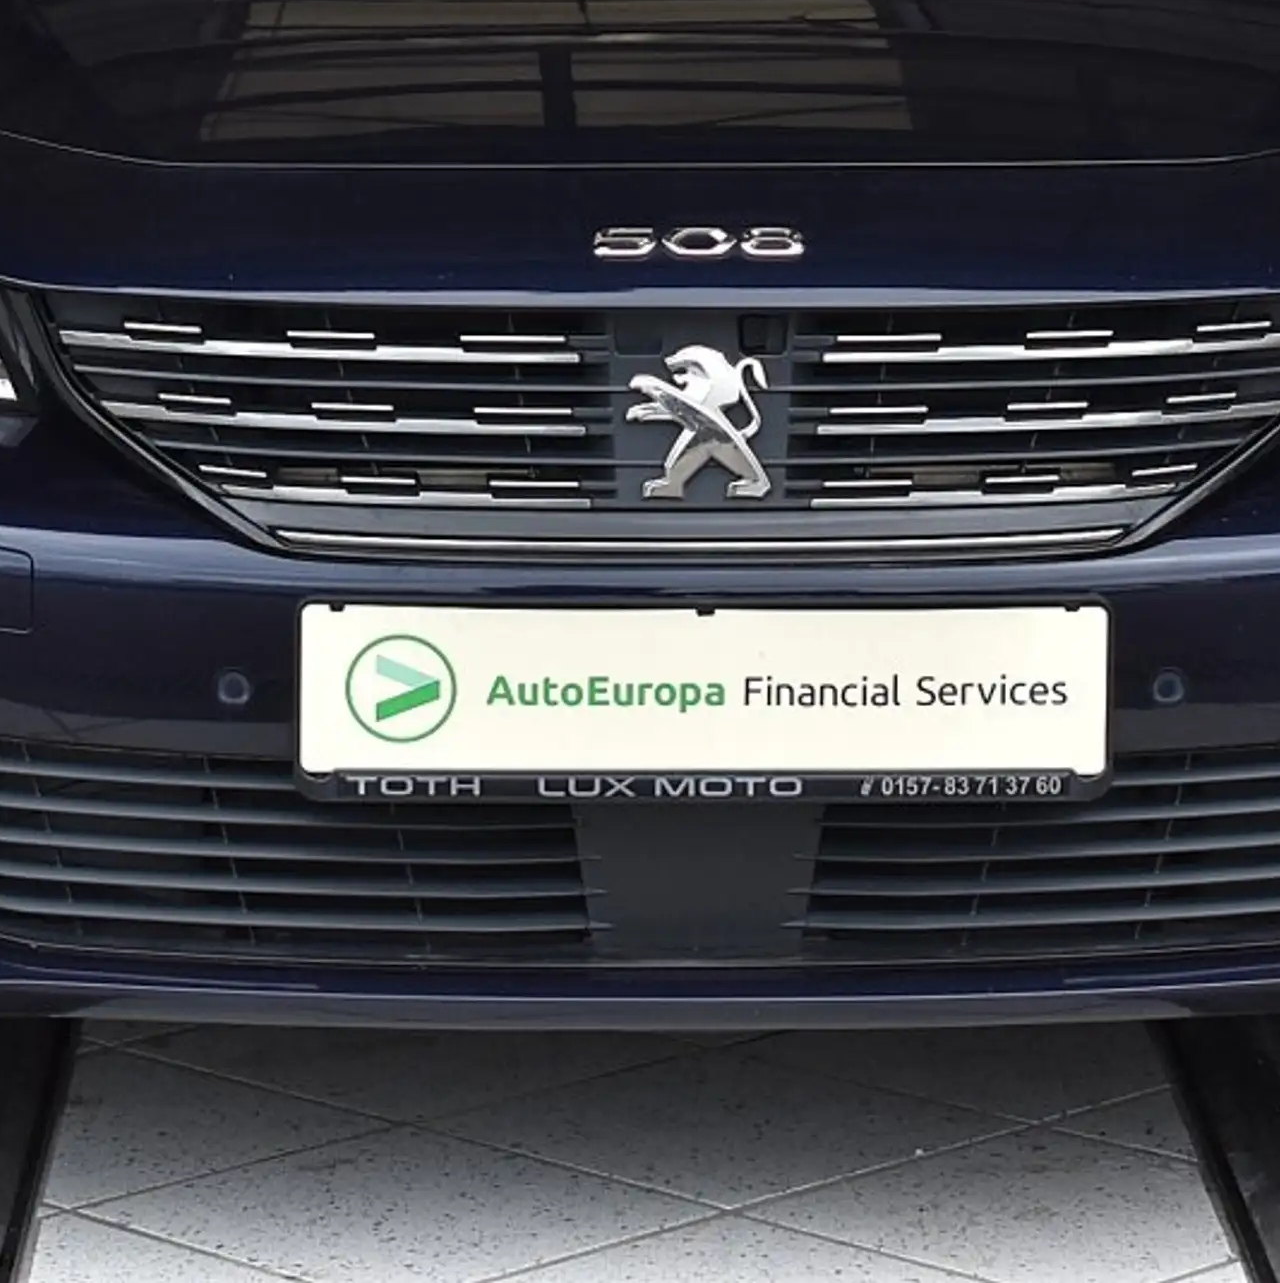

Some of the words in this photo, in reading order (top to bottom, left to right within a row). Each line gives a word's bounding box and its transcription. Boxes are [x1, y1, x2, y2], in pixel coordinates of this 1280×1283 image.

[593, 226, 805, 260] 508
[486, 674, 727, 715] AutoEuropa
[742, 673, 902, 708] Financial
[914, 673, 1070, 708] Services
[345, 775, 481, 796] TOTH
[538, 776, 636, 797] LUX
[654, 776, 802, 797] MOTO
